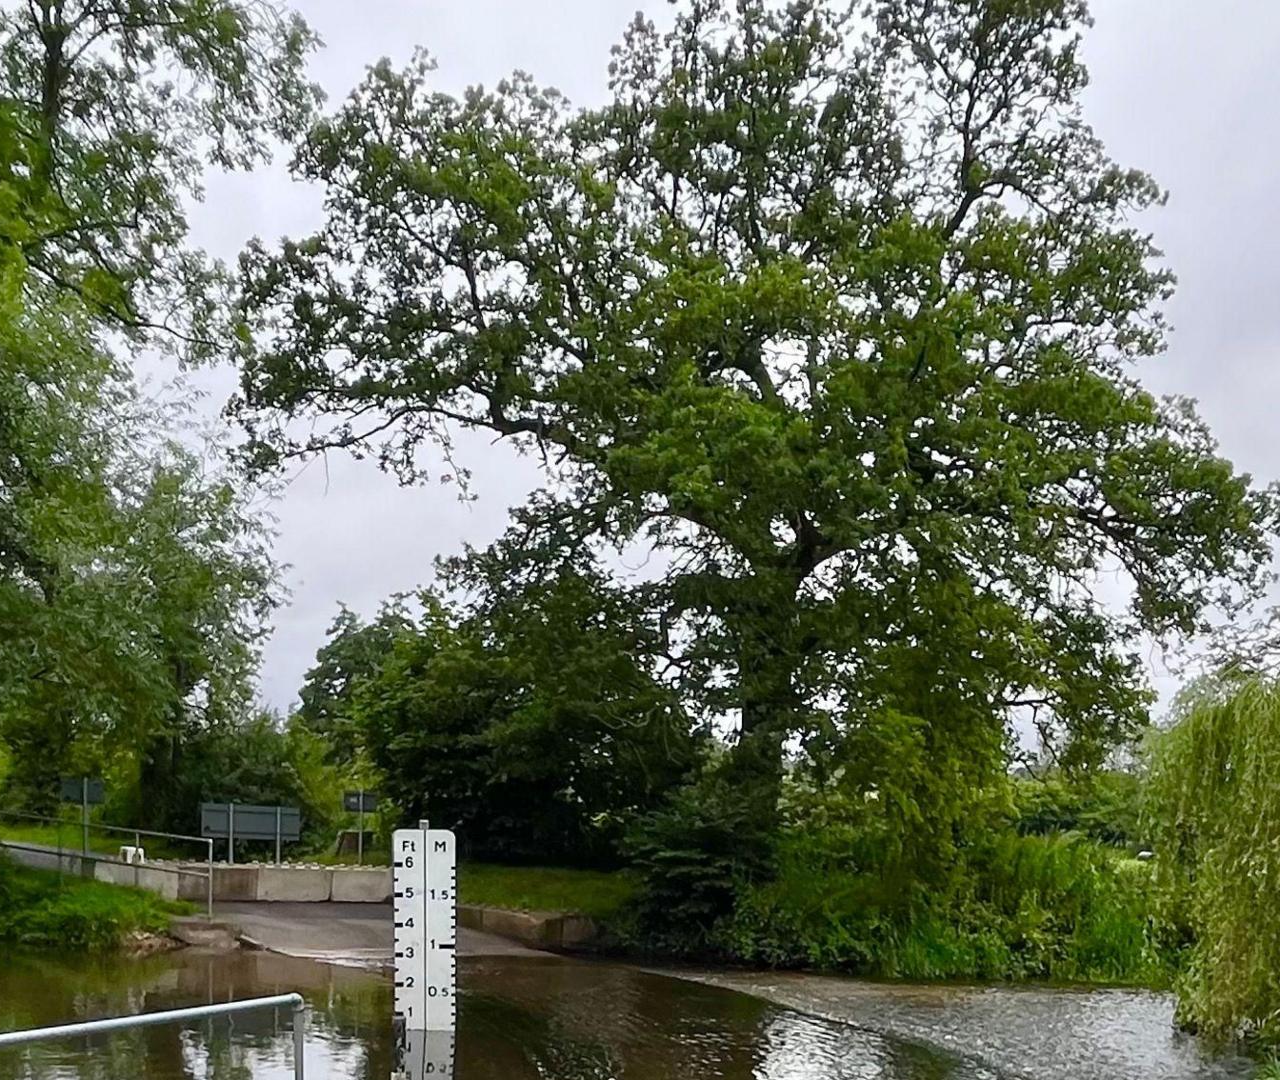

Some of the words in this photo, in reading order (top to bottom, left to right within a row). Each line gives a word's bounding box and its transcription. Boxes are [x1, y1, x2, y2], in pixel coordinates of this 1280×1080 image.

[402, 840, 416, 853] Ft
[434, 840, 447, 853] M
[404, 856, 415, 869] 6
[405, 886, 415, 899] 5
[429, 888, 449, 901] 1.5
[404, 917, 415, 929] 4
[405, 946, 415, 959] 3
[405, 976, 415, 989] 2
[427, 985, 449, 998] 0.5
